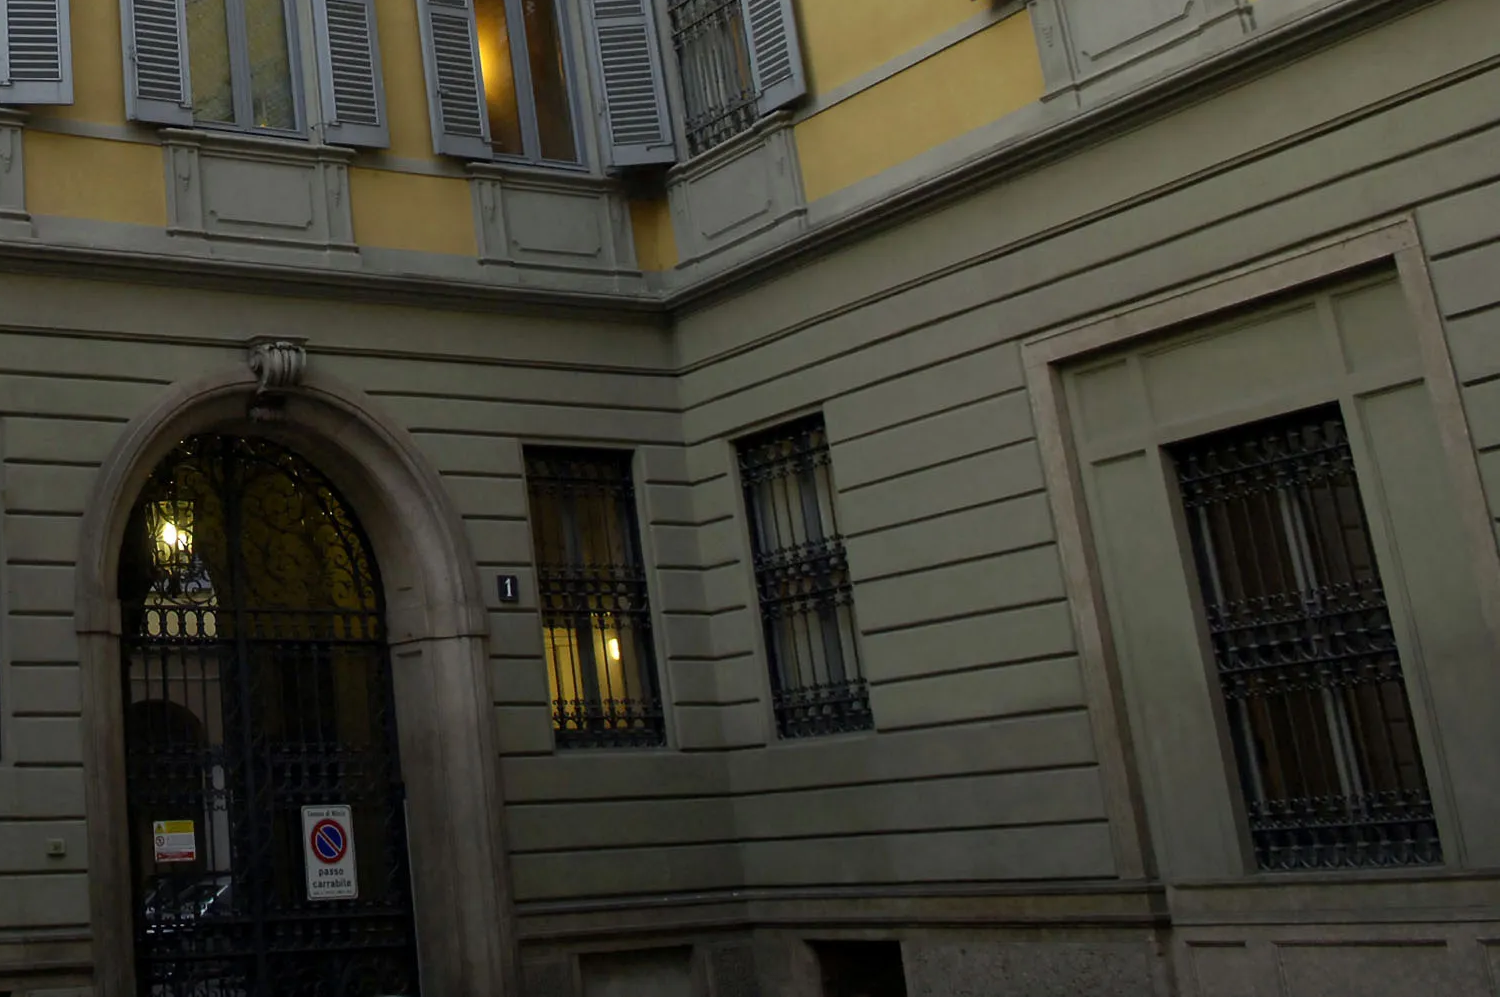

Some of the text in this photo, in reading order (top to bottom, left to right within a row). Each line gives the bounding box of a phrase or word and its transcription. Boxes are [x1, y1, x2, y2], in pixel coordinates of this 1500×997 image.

[504, 577, 513, 597] 1
[318, 868, 344, 877] passo
[312, 878, 352, 888] carrabile
